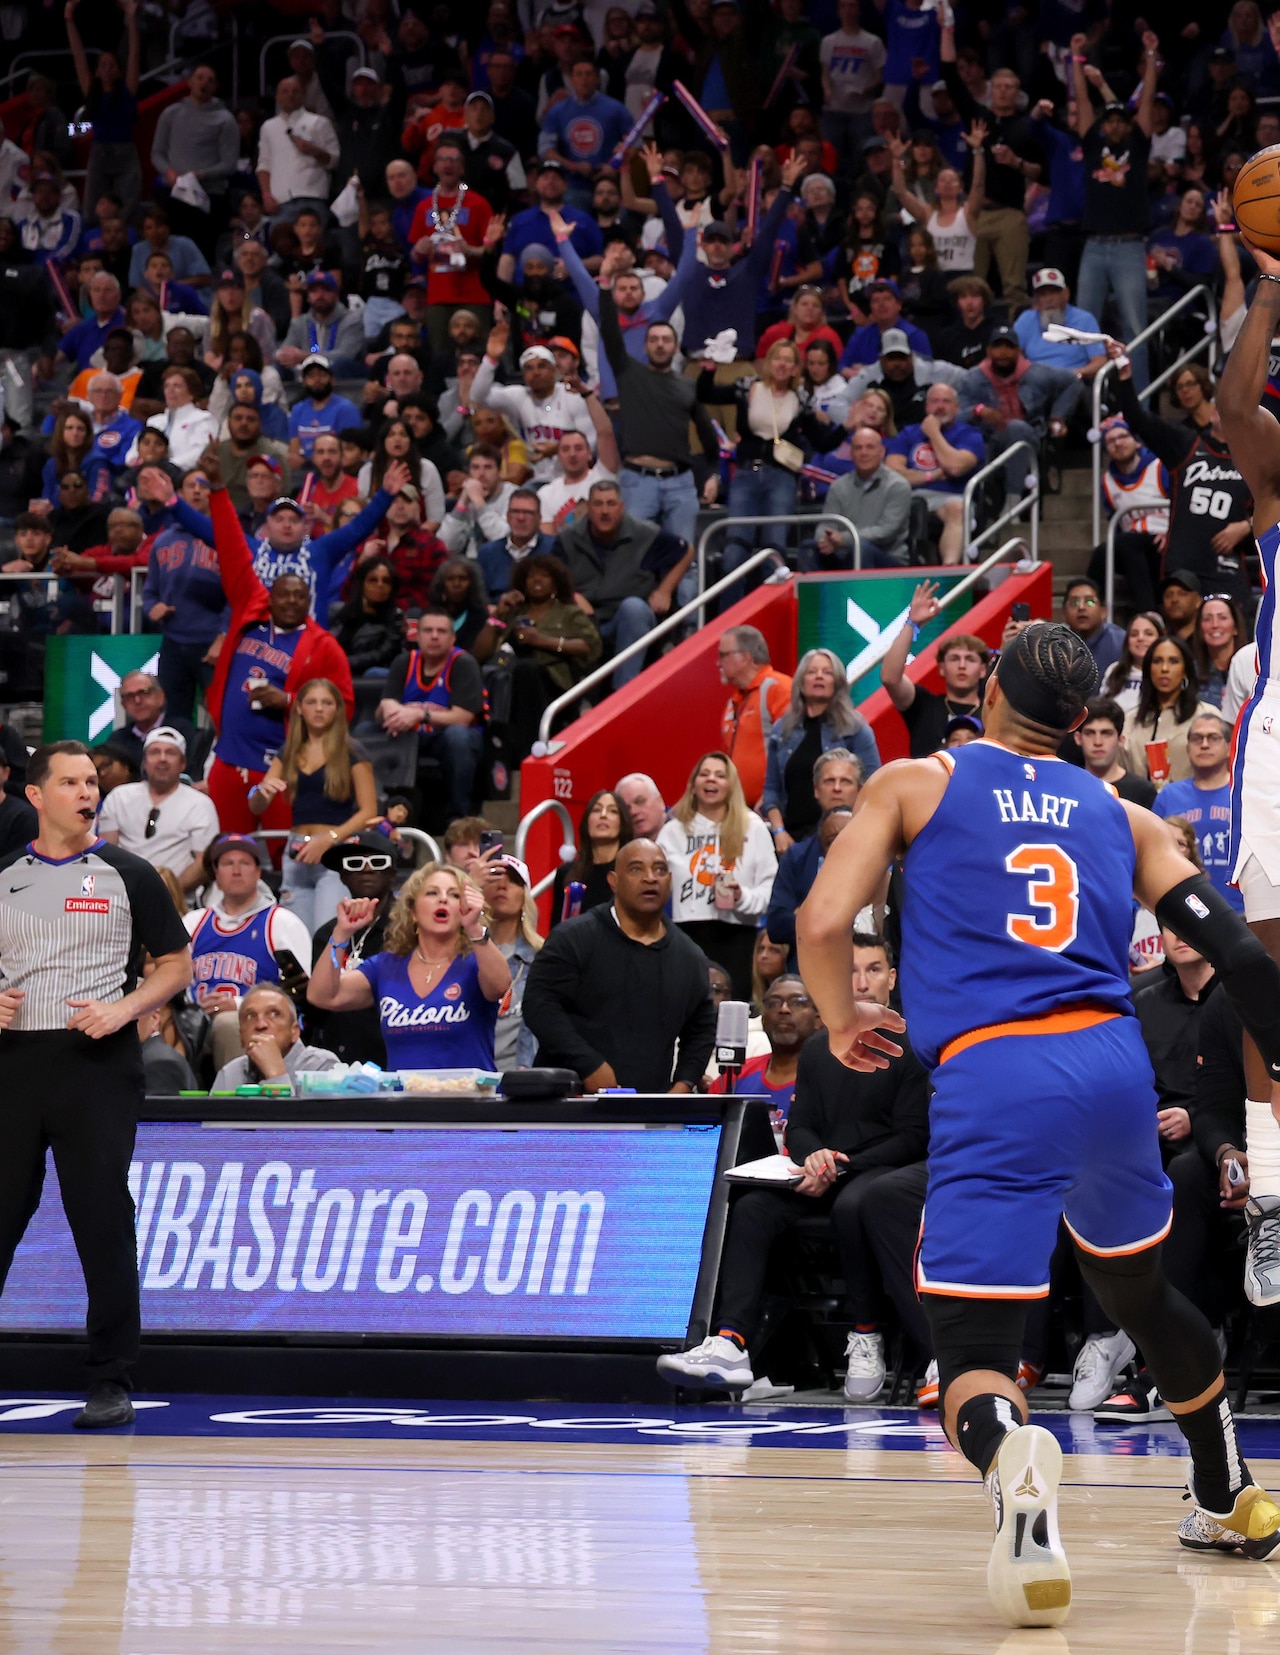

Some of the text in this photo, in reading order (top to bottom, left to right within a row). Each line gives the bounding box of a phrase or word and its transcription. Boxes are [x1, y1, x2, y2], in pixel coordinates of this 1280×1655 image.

[1189, 486, 1233, 521] 50
[554, 777, 573, 799] 122
[993, 789, 1079, 828] HART
[66, 900, 109, 912] Emirates
[1005, 844, 1080, 953] 3
[379, 996, 470, 1028] Pistons
